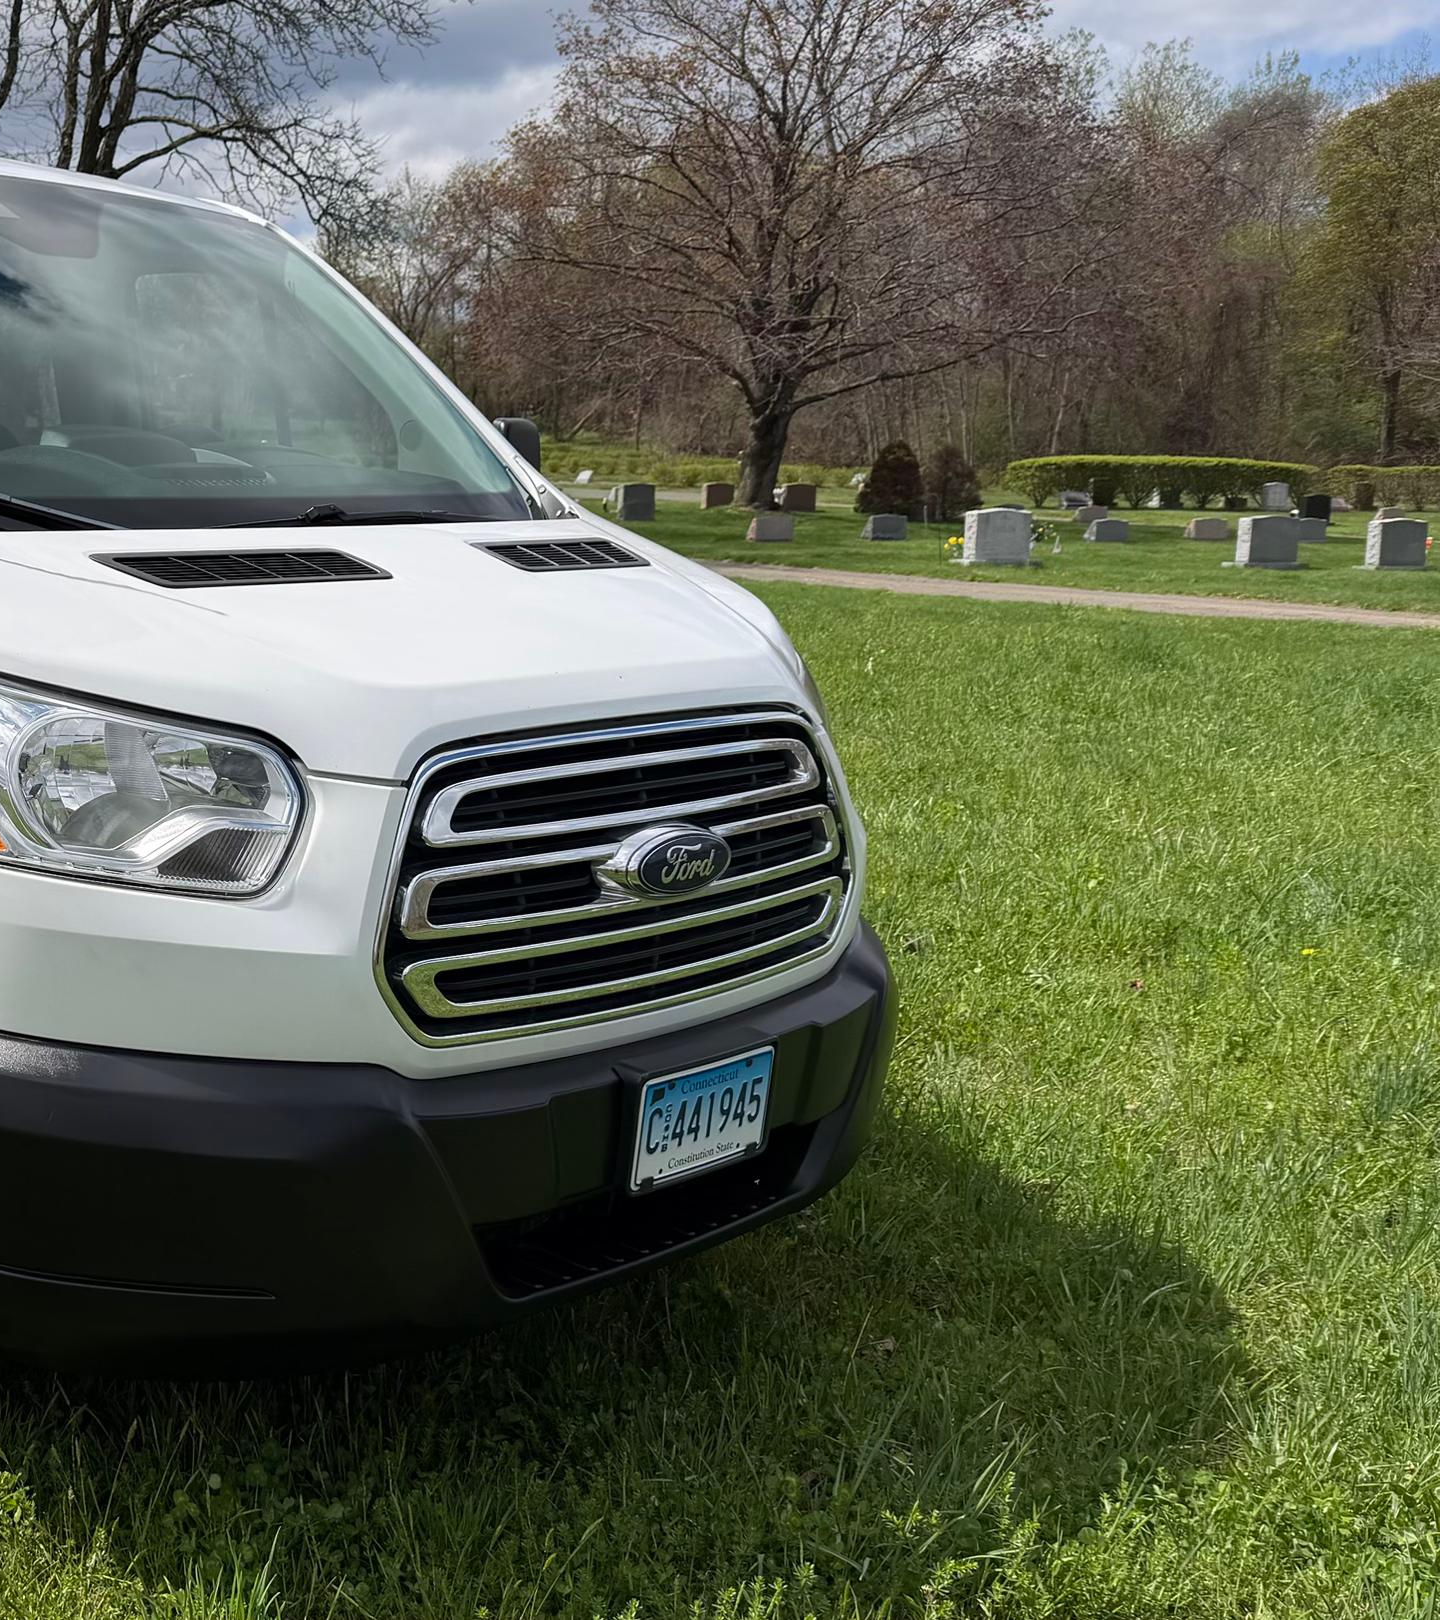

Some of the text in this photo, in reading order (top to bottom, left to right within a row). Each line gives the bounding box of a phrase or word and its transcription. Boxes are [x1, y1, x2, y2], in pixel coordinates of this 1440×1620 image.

[661, 843, 716, 884] Ford
[681, 1069, 739, 1094] Connecticut
[668, 1141, 734, 1169] Constitution State
